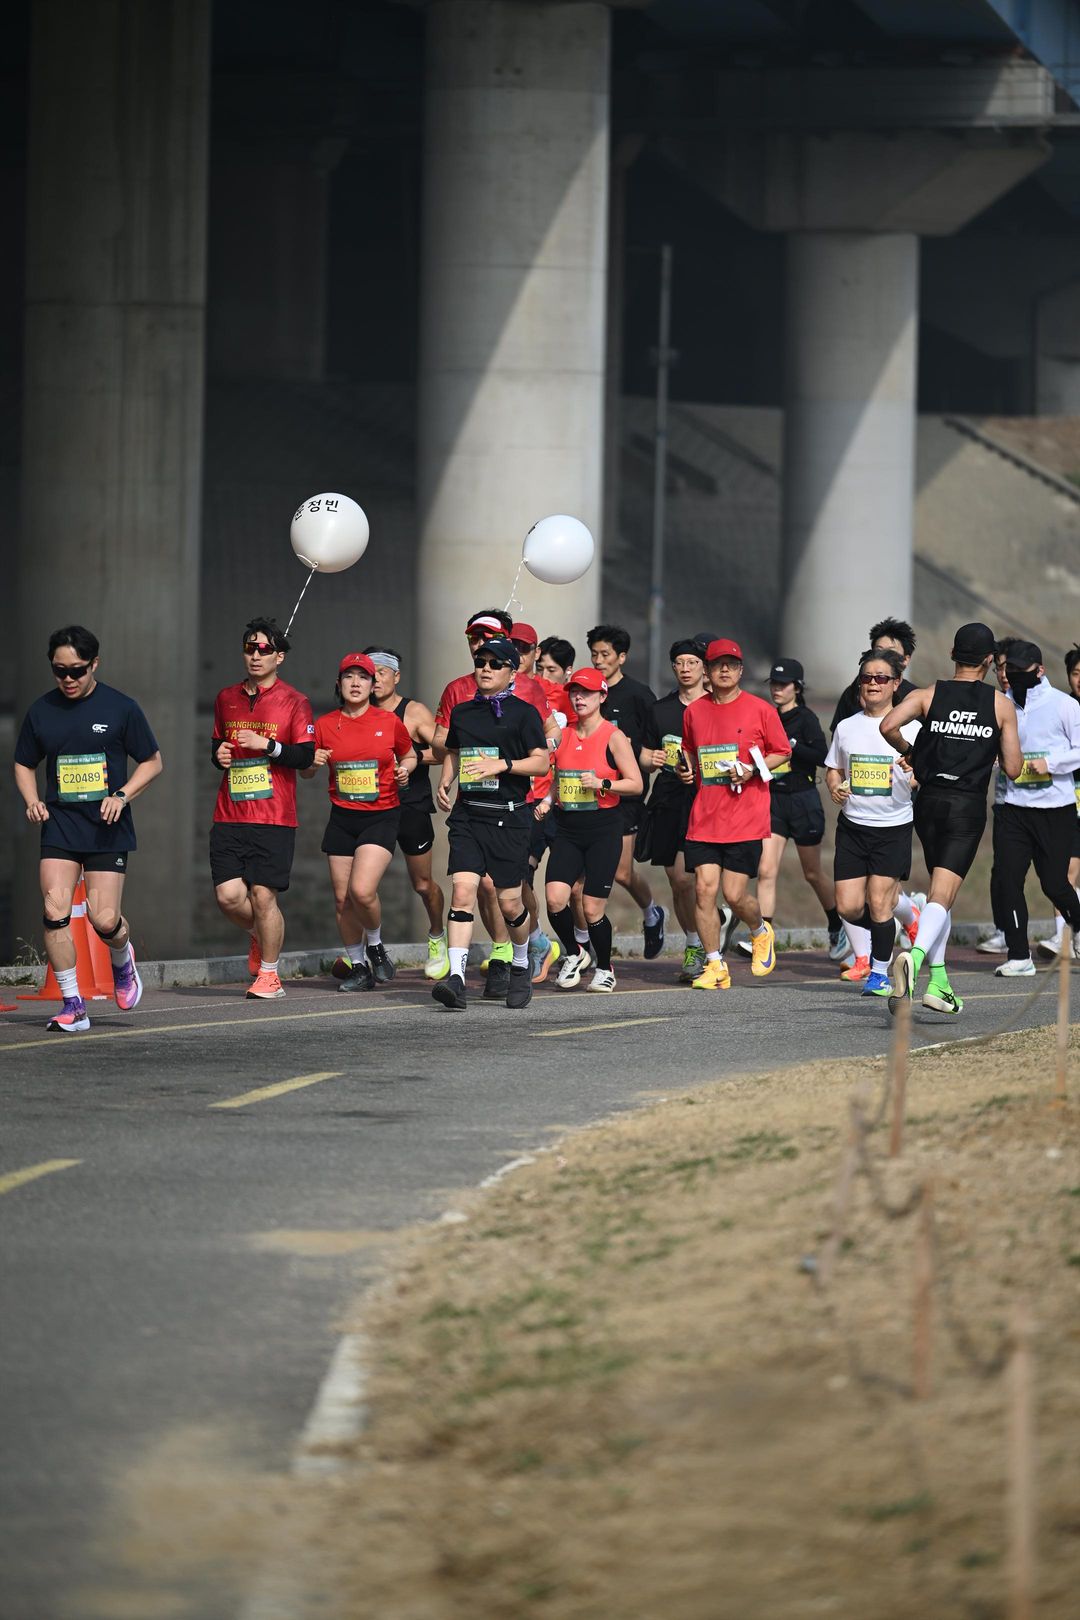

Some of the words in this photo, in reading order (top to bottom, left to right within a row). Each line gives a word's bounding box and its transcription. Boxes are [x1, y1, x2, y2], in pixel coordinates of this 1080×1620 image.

[949, 710, 977, 723] OFF
[930, 720, 993, 738] RUNNING
[62, 772, 101, 784] C20489
[232, 774, 266, 785] D20558
[853, 770, 887, 780] D20550
[341, 777, 372, 786] D20581
